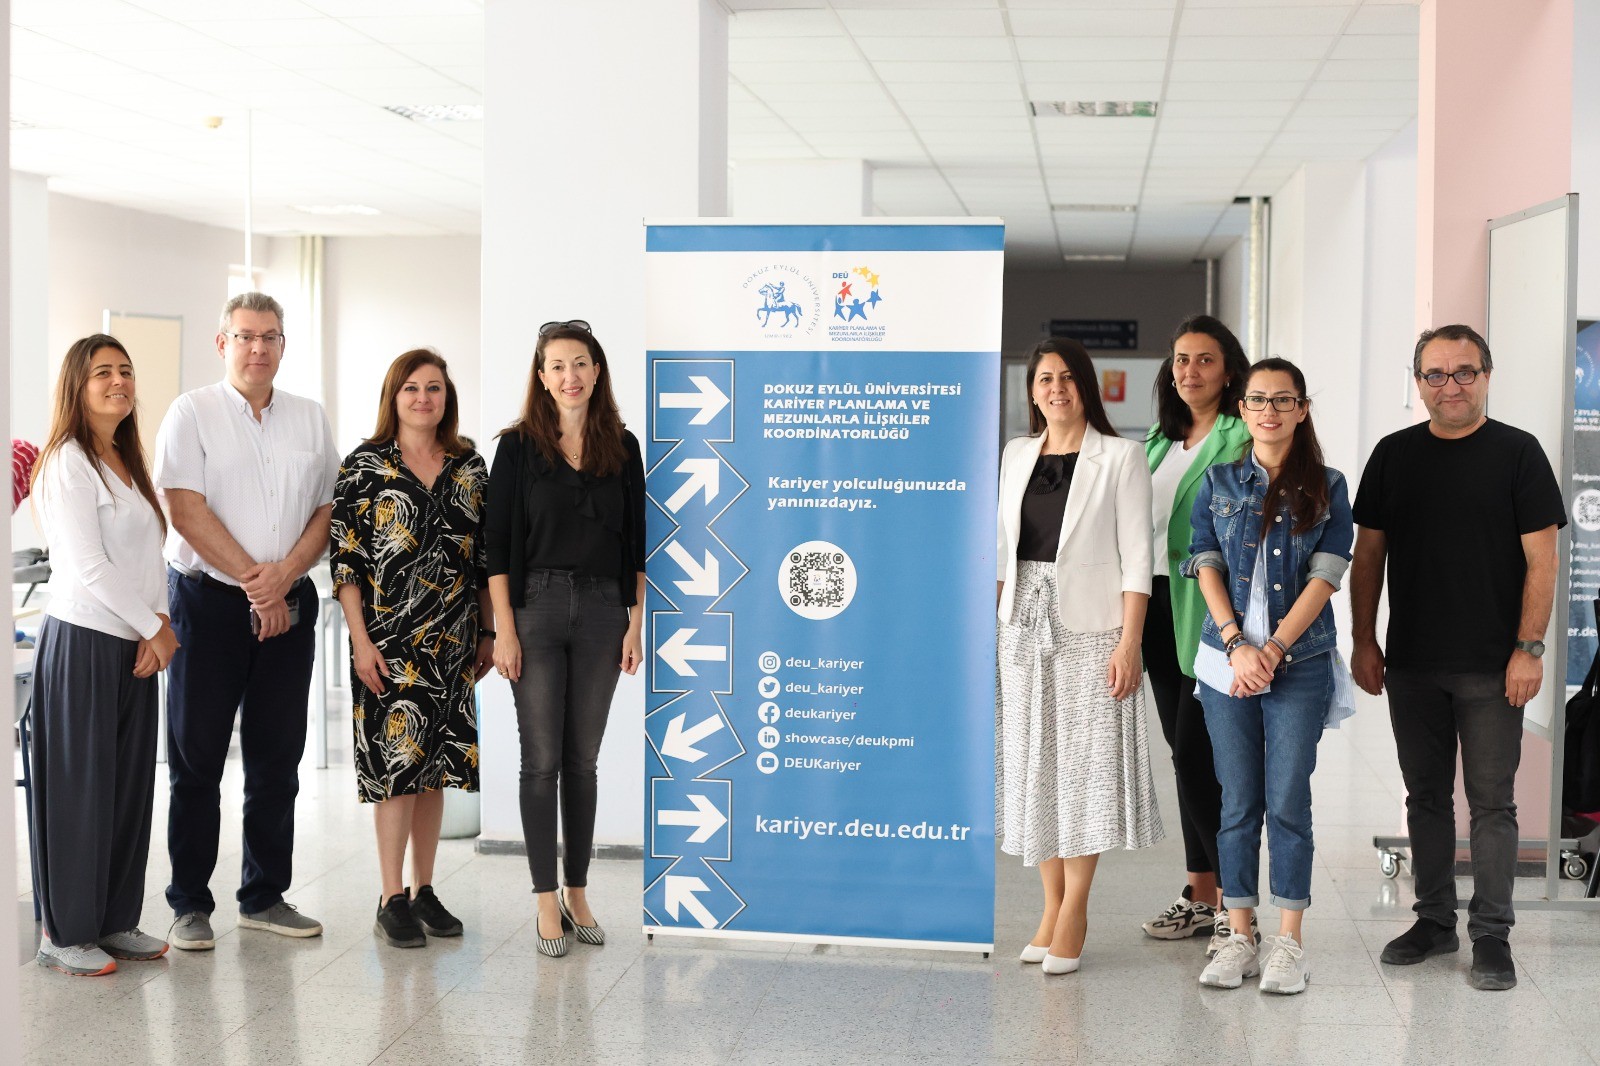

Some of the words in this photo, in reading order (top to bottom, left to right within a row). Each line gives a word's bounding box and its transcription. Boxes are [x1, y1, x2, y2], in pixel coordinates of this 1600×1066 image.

[742, 266, 769, 289] DOKUZ
[773, 264, 801, 276] EYLÜL
[832, 271, 849, 279] DEÜ
[763, 384, 814, 395] DOKUZ
[818, 382, 861, 395] EYLÜL
[865, 381, 961, 396] ÜNİVERSİTESİ
[763, 397, 824, 410] KARİYER
[828, 399, 907, 410] PLANLAMA
[911, 400, 931, 410] VE
[763, 413, 860, 425] MEZUNLARLA
[864, 412, 930, 427] İLİŞKİLER
[763, 427, 910, 440] KOORDİNATORLÜĞÜ
[768, 476, 828, 493] Kariyer
[832, 477, 966, 494] yolculuğunuzda
[767, 496, 877, 512] yanınızdayız.
[785, 657, 865, 671] deu_kariyer
[785, 682, 864, 697] deu_kariyer
[784, 707, 857, 722] deukariyer
[764, 732, 775, 743] in
[784, 731, 914, 748] showcase/deukpmi
[784, 757, 862, 772] DEUKariyer
[755, 815, 971, 841] kariyer.deu.edu.tr
